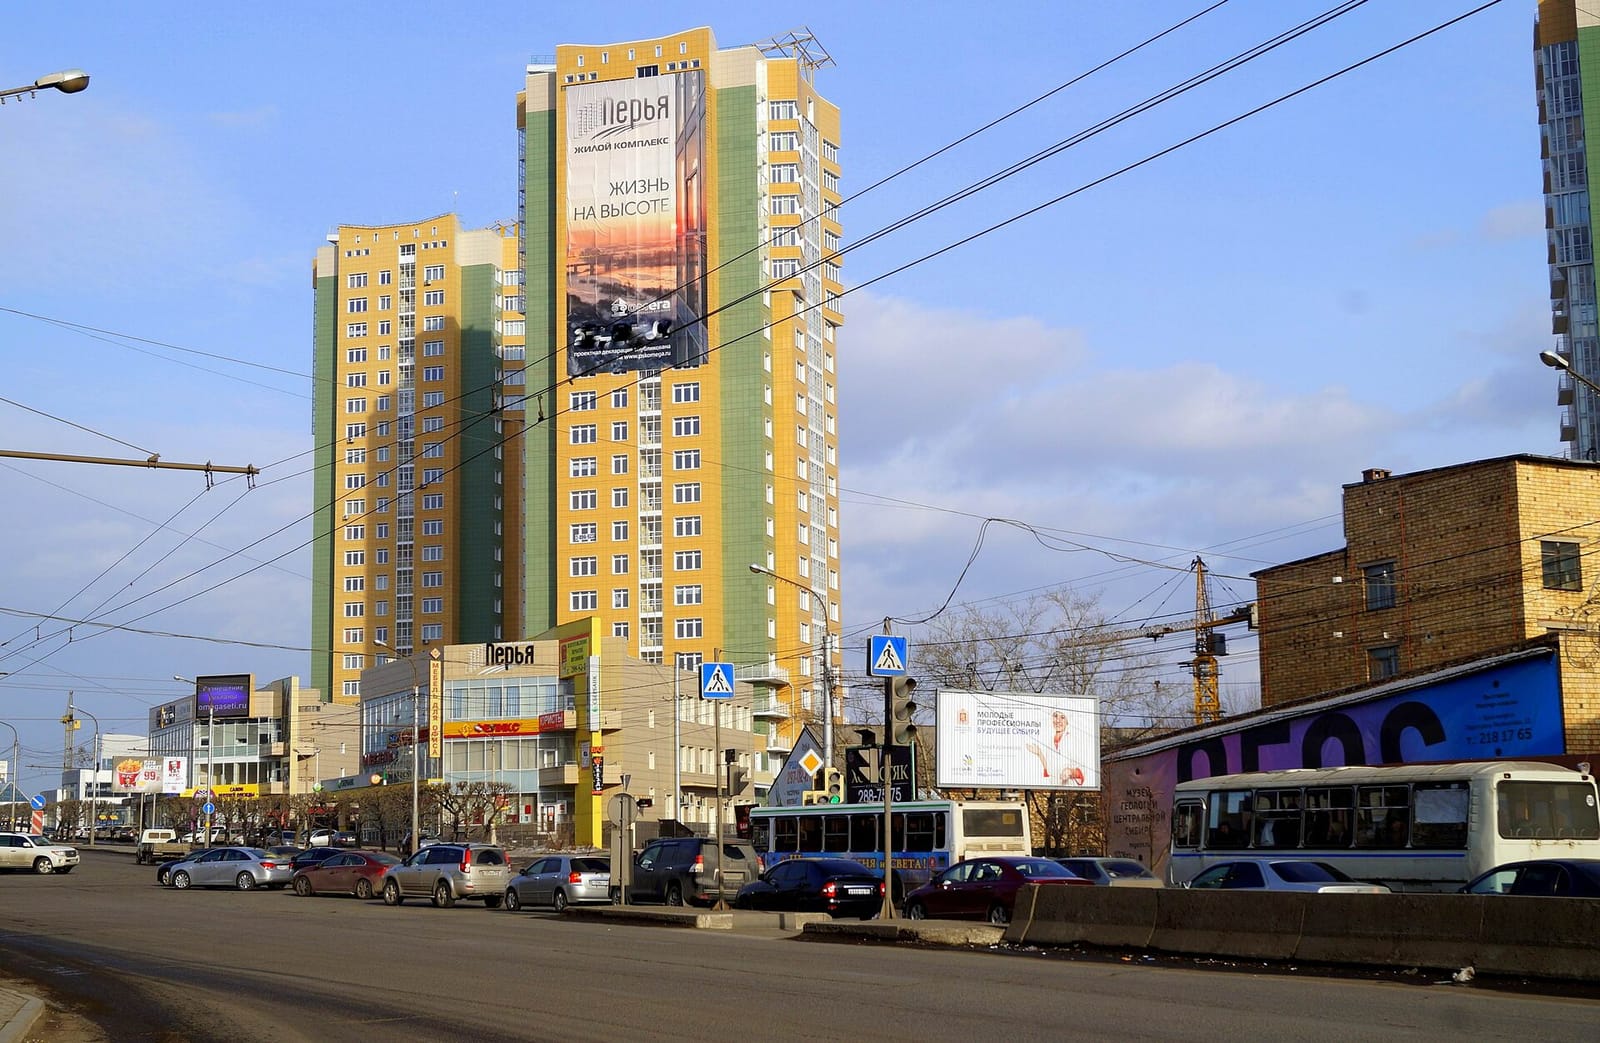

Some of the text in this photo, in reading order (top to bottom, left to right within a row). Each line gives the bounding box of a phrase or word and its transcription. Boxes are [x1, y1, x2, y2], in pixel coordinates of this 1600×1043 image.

[603, 95, 669, 129] Перья
[574, 137, 669, 154] ЖИЛОЙ КОМПЛЕКС
[609, 177, 670, 197] ЖИЗНЬ
[574, 198, 670, 221] НА ВЫСОТЕ
[486, 643, 535, 670] Перья
[977, 711, 1015, 720] МОЛОДЫЕ
[977, 719, 1042, 728] ПРОФЕССИОНАЛЫ
[977, 727, 1040, 736] БУДУЩЕЕ СИБИРИ
[1479, 732, 1498, 744] 218
[1502, 730, 1514, 742] 17
[1517, 728, 1532, 741] 65
[431, 725, 439, 756] ОФИСА
[144, 771, 156, 781] 99
[1126, 787, 1152, 798] МУЗЕЙ
[1120, 799, 1159, 811] ГЕОЛОГИИ
